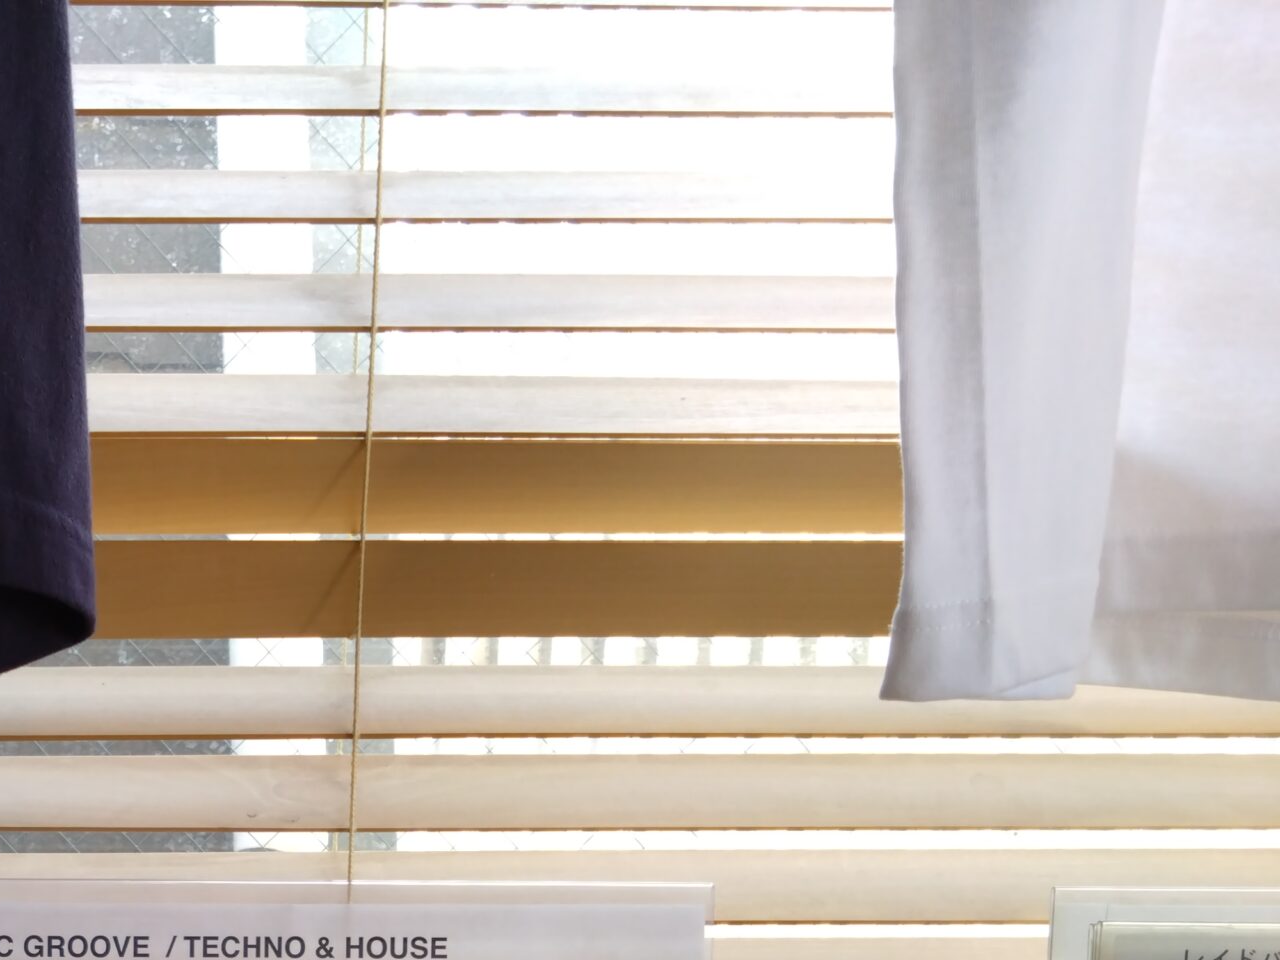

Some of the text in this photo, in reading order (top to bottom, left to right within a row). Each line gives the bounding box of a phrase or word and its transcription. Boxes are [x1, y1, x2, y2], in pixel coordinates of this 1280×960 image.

[23, 934, 150, 959] GROOVE
[315, 936, 335, 959] &
[345, 936, 448, 960] HOUSE
